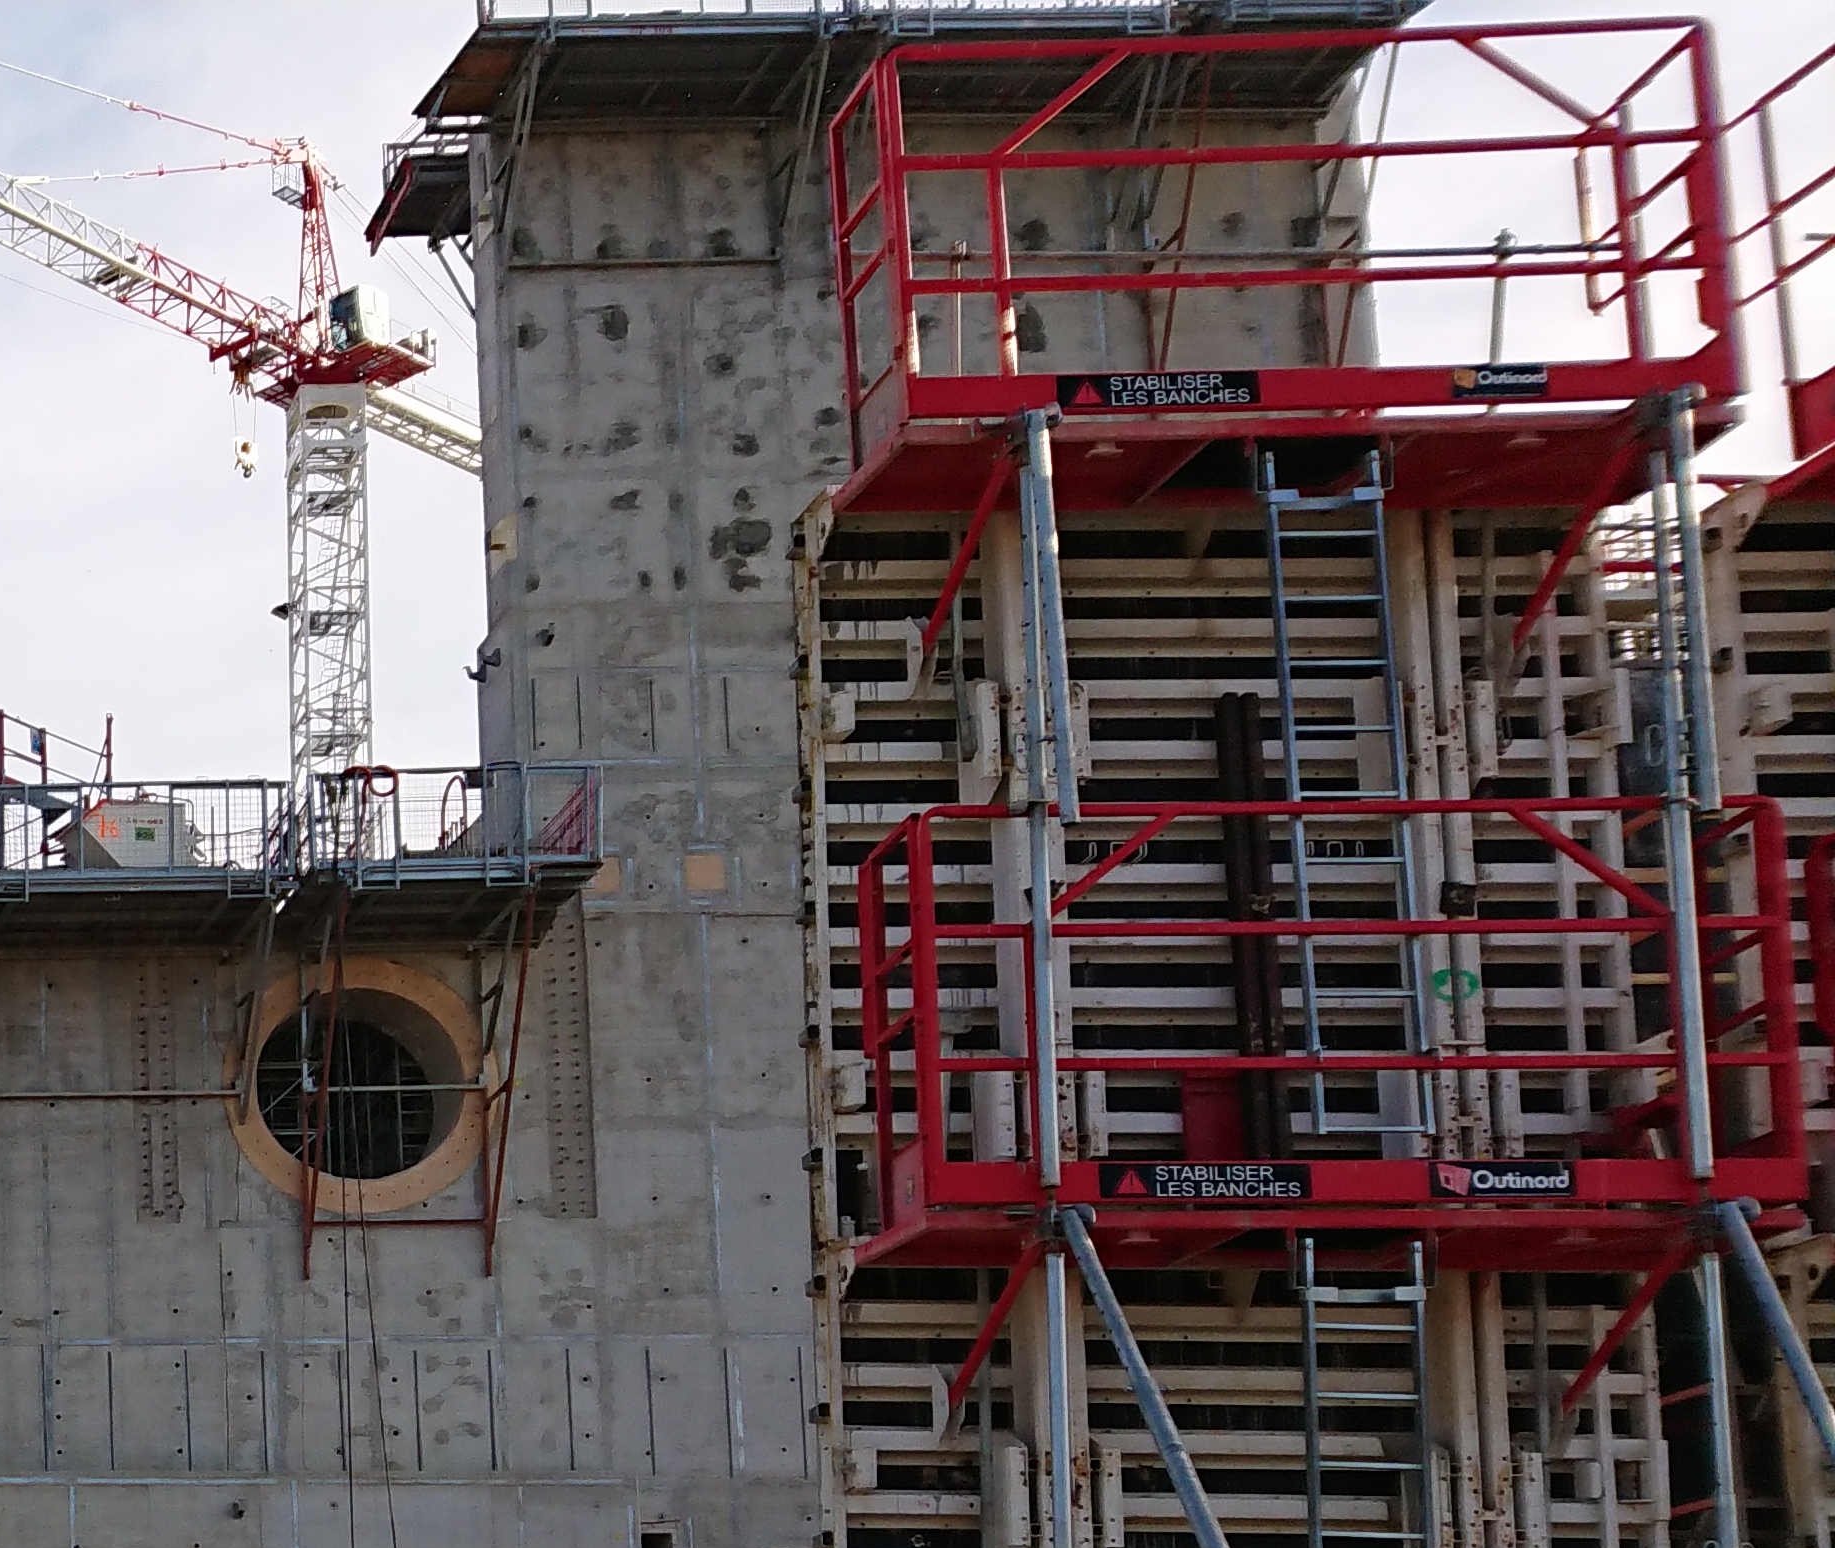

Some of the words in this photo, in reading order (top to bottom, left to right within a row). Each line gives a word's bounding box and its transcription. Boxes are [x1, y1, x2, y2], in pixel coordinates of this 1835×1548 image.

[1110, 374, 1223, 391] STABILISER
[1111, 391, 1150, 406] LES
[1155, 388, 1251, 405] BANCHES
[1155, 1166, 1274, 1181] STABILISER
[1473, 1169, 1570, 1189] Outinord
[1156, 1182, 1195, 1197] LES
[1202, 1182, 1301, 1197] BANCHES
